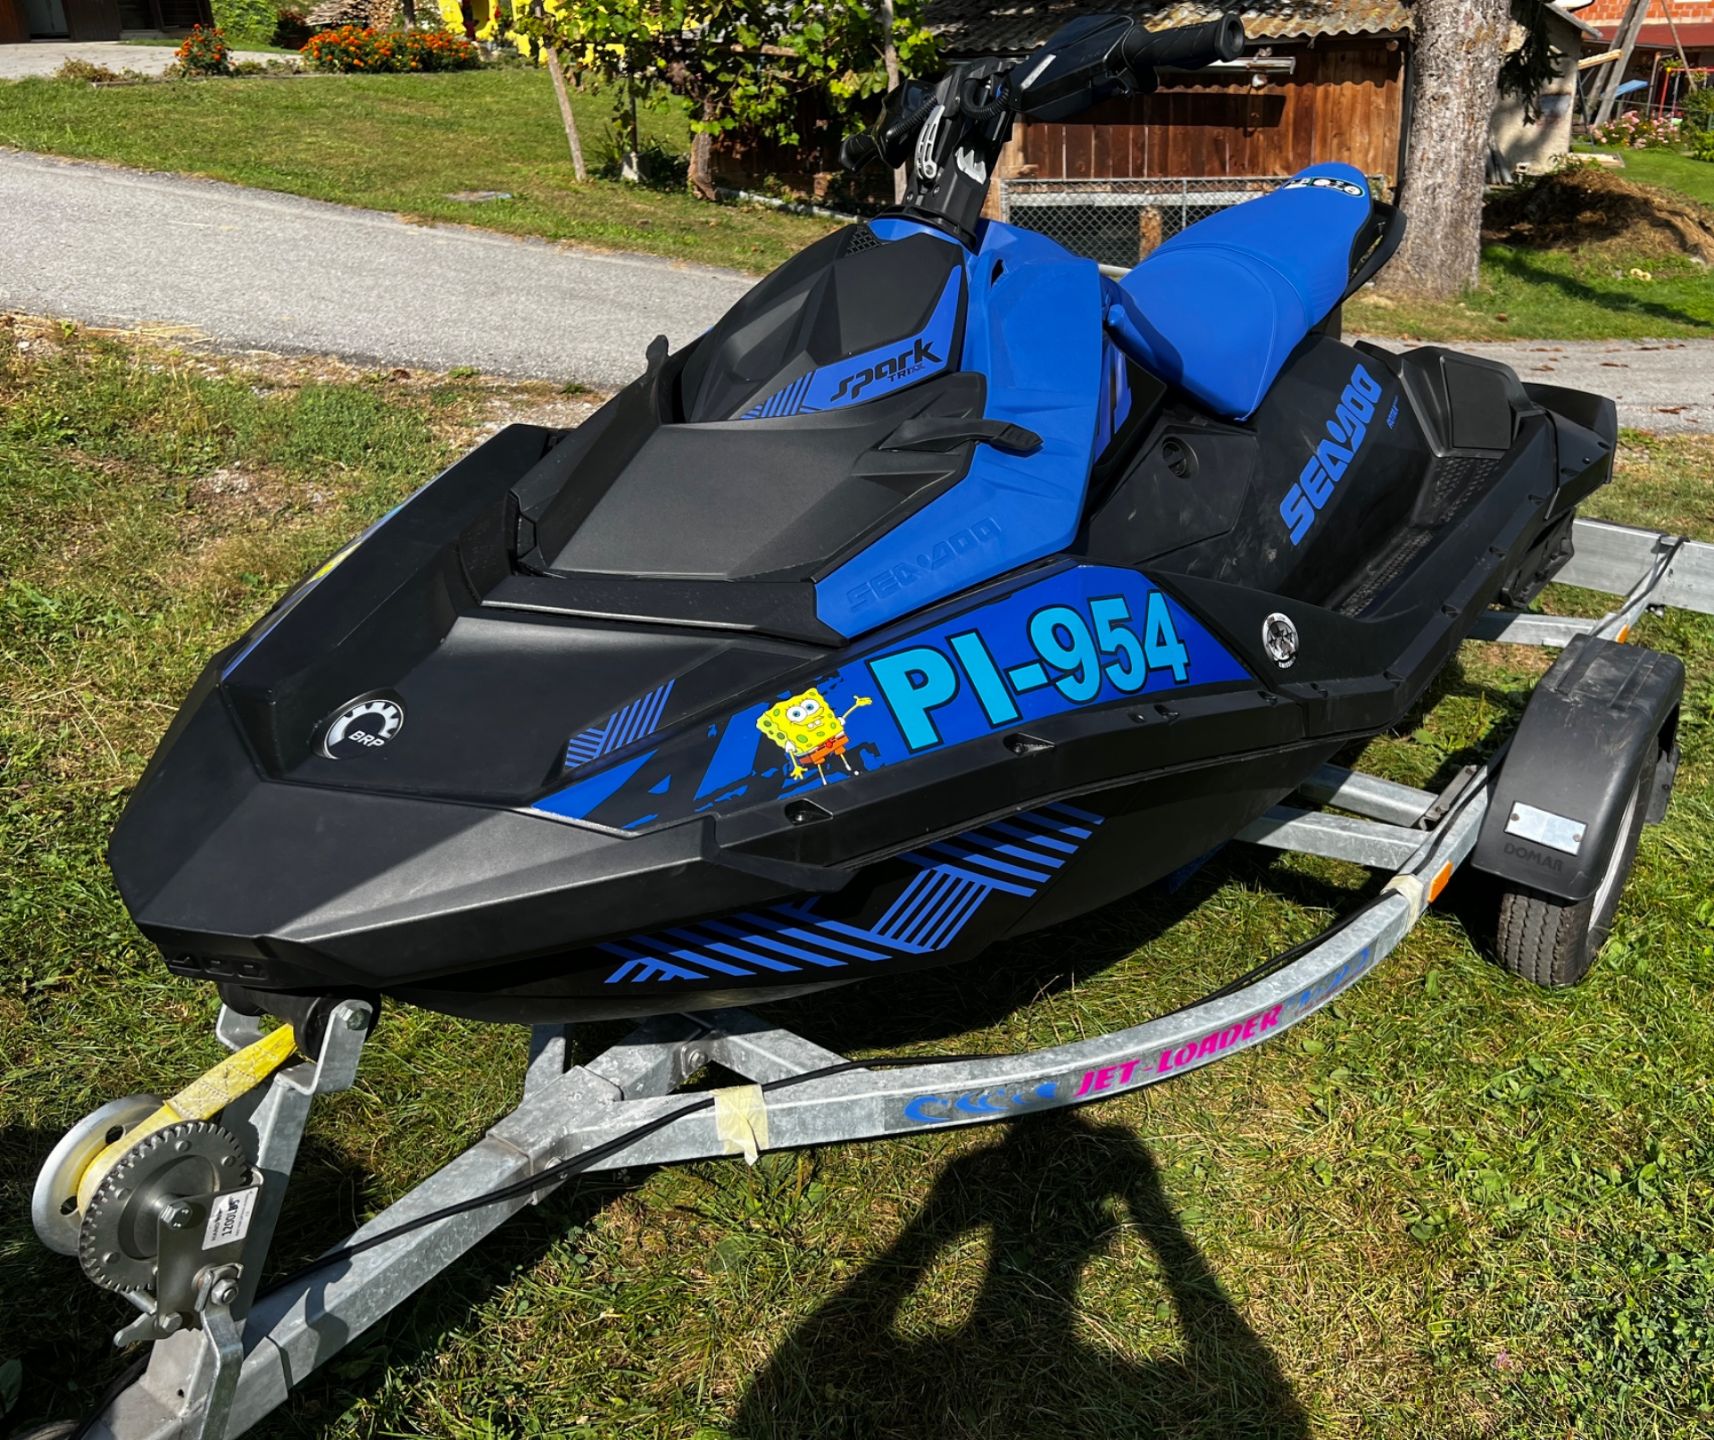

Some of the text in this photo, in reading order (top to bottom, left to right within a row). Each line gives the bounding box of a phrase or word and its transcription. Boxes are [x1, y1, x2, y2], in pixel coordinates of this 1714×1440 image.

[865, 588, 1190, 754] PI-954
[348, 730, 385, 747] BRP
[1503, 842, 1564, 872] DOMAR
